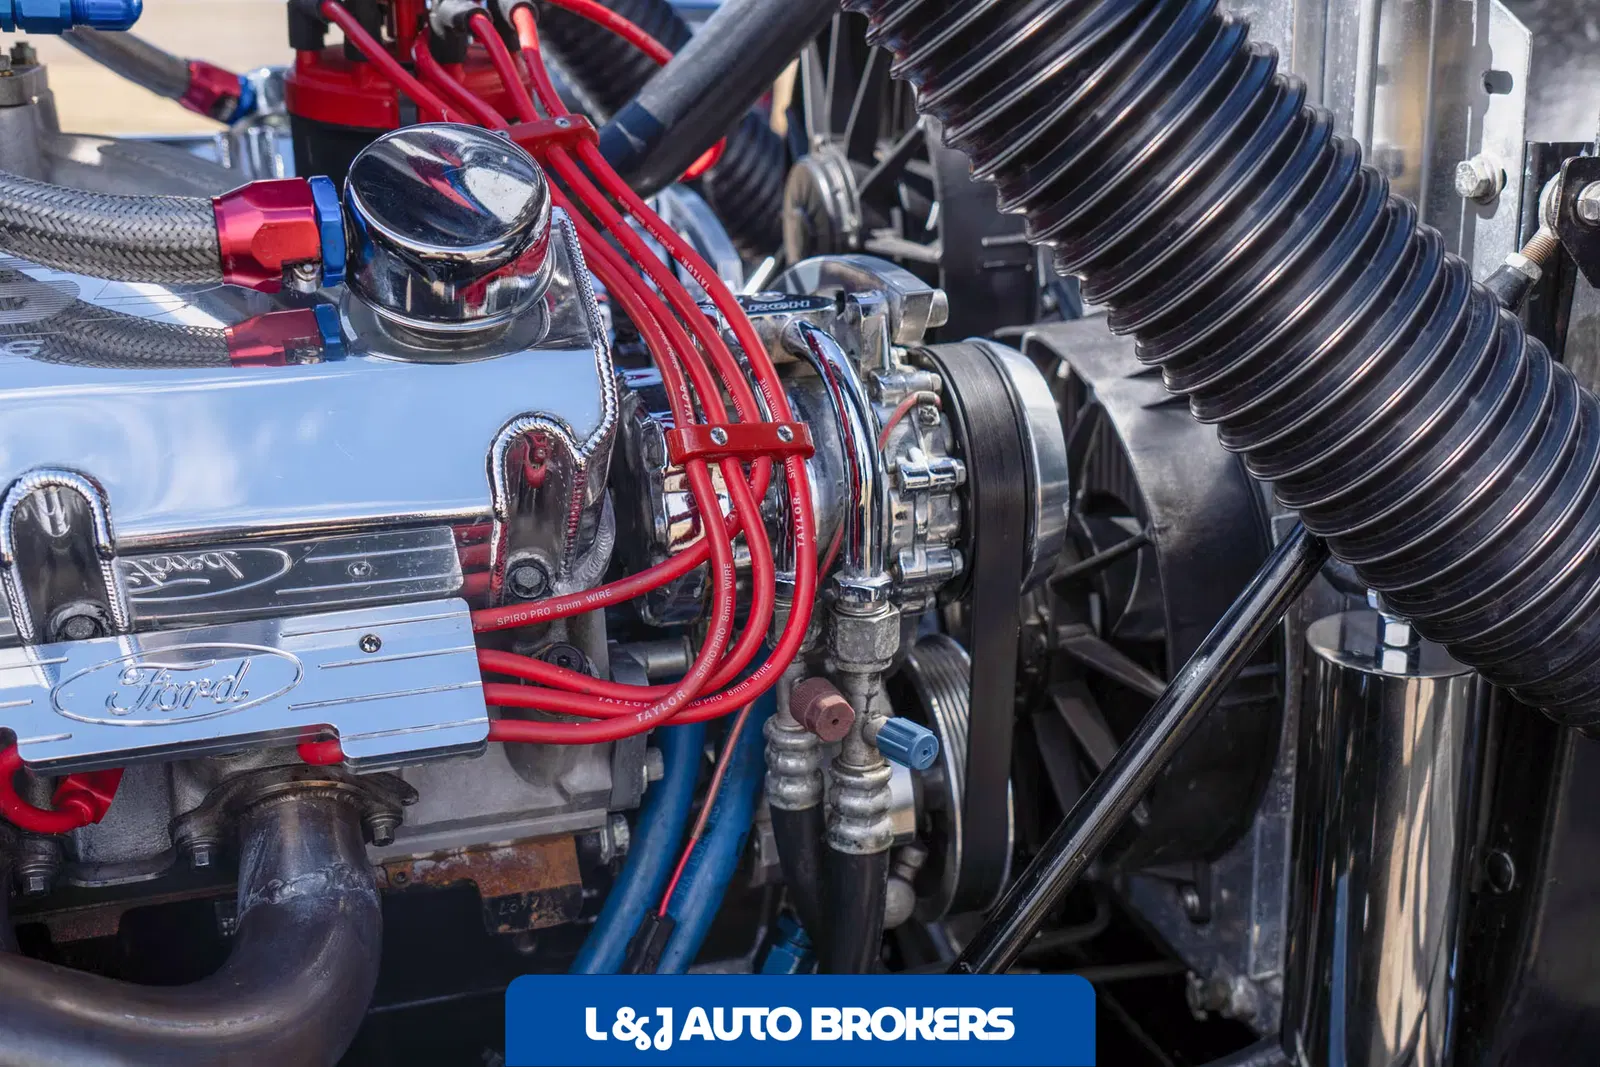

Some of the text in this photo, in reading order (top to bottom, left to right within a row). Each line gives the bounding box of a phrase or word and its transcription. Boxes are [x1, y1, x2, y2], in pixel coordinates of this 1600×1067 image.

[681, 256, 711, 291] TAYLOR
[680, 381, 696, 425] AYLOR
[760, 377, 771, 401] WIRE
[786, 456, 797, 479] SPIR
[793, 493, 806, 547] TAYLOR
[497, 612, 528, 626] SPIRO
[530, 607, 551, 619] PRO
[556, 600, 581, 613] 8mm
[586, 588, 612, 604] WIRE
[635, 563, 732, 723] TAYLOR SPIRO PRO 8mm WIRE
[105, 658, 251, 717] Ford
[703, 694, 723, 705] PRO
[726, 681, 750, 696] 8mm
[751, 662, 773, 681] WIRE
